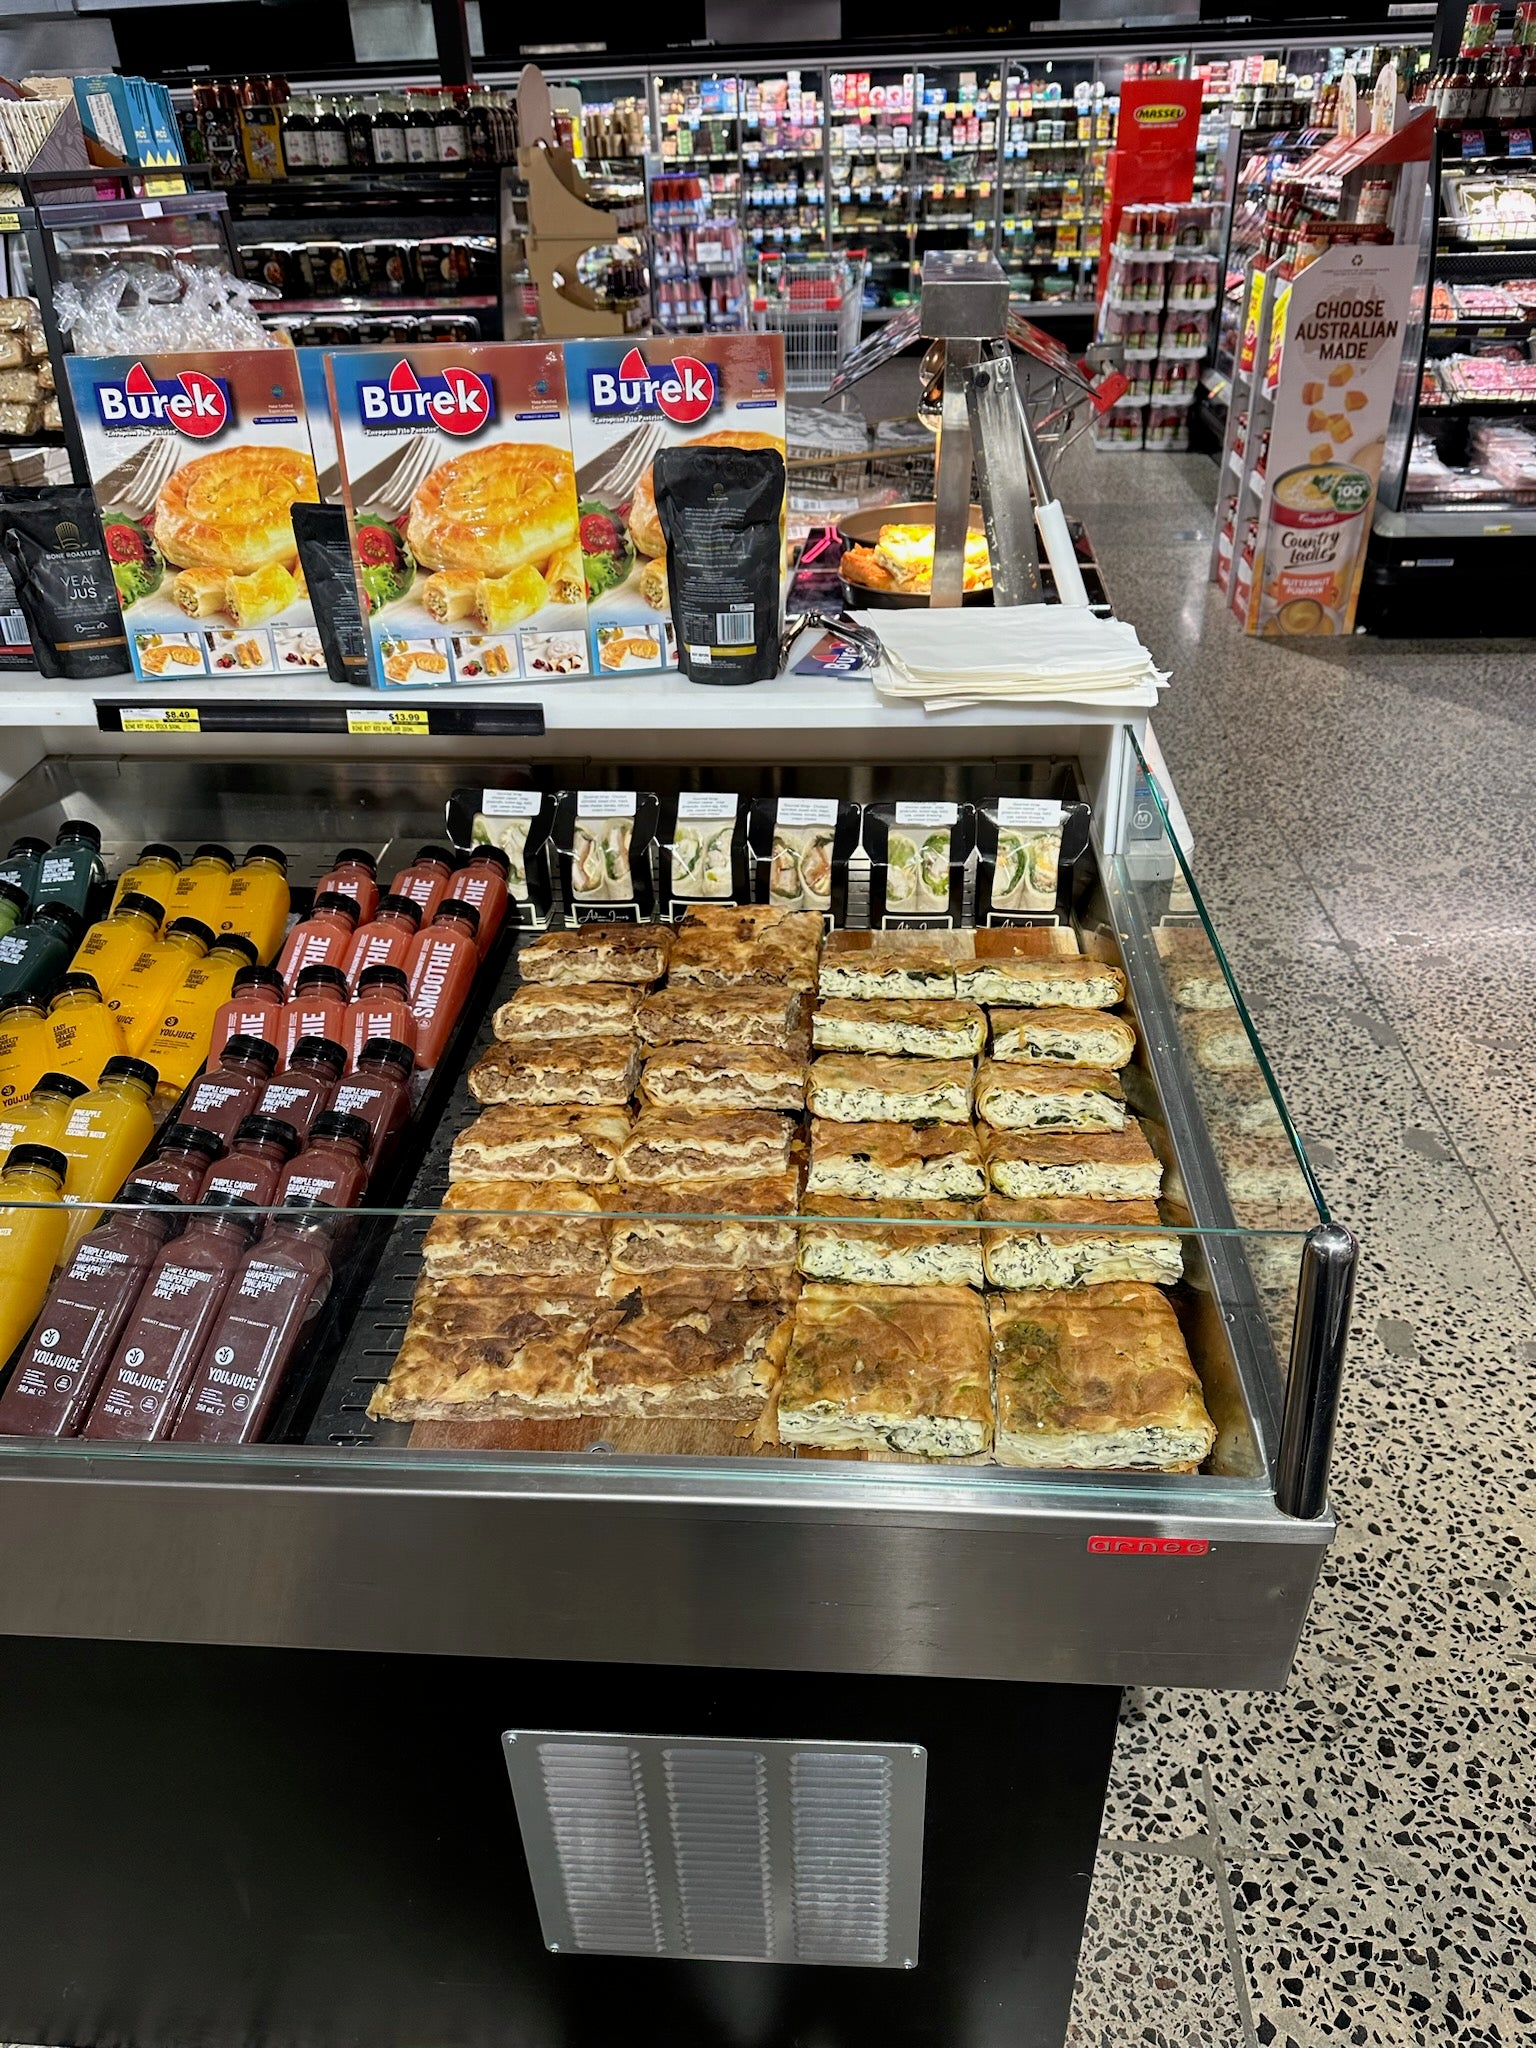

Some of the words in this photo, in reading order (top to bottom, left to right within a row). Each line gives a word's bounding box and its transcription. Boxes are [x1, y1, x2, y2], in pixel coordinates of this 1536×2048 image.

[1138, 109, 1183, 118] MASSEL
[1316, 300, 1385, 319] CHOOSE
[1295, 321, 1398, 340] AUSTRALIAN
[1319, 342, 1368, 360] MADE
[592, 368, 708, 406] Burek
[99, 383, 221, 420] Burek
[362, 379, 484, 418] Burek
[1281, 530, 1340, 549] Country
[66, 549, 101, 558] ROASTERS
[60, 575, 99, 587] VEAL
[1282, 577, 1331, 586] BUTTERNUT
[70, 587, 97, 600] JUS
[1287, 586, 1325, 595] PUMPKIN
[165, 711, 190, 719] $8.49
[388, 713, 420, 721] $13.99
[412, 941, 456, 1018] SMOOTHIE
[160, 1028, 197, 1040] YOUJUICE
[196, 1090, 229, 1101] GRAPEFRUIT
[199, 1084, 220, 1093] PURPLE
[219, 1086, 241, 1097] CARROT
[265, 1092, 297, 1102] GRAPEFRUIT
[268, 1084, 288, 1094] PURPLE
[287, 1087, 310, 1098] CARROT
[339, 1085, 361, 1094] PURPLE
[360, 1088, 382, 1098] CARROT
[193, 1098, 223, 1108] PINEAPPLE
[263, 1098, 291, 1108] PINEAPPLE
[335, 1099, 364, 1109] PINEAPPLE
[337, 1093, 370, 1103] GRAPEFRUIT
[73, 1109, 102, 1118] PINEAPPLE
[190, 1104, 209, 1113] APPLE
[260, 1104, 279, 1114] APPLE
[333, 1106, 351, 1114] APPLE
[156, 1181, 180, 1193] CARROT
[211, 1177, 235, 1188] PURPLE
[234, 1180, 258, 1191] CARROT
[288, 1175, 312, 1186] PURPLE
[311, 1178, 336, 1189] CARROT
[286, 1185, 323, 1196] GRAPEFRUIT
[80, 1244, 104, 1257] PURPLE
[103, 1249, 129, 1263] CARROT
[76, 1253, 114, 1268] GRAPEFRUIT
[68, 1270, 90, 1281] APPLE
[72, 1262, 106, 1276] PINEAPPLE
[163, 1263, 188, 1277] PURPLE
[187, 1269, 213, 1282] CARROT
[248, 1260, 274, 1273] PURPLE
[273, 1266, 298, 1279] CARROT
[160, 1271, 198, 1288] GRAPEFRUIT
[245, 1269, 285, 1285] GRAPEFRUIT
[156, 1279, 191, 1295] PINEAPPLE
[242, 1277, 277, 1292] PINEAPPLE
[152, 1288, 174, 1300] APPLE
[239, 1286, 260, 1298] APPLE
[32, 1349, 82, 1373] YOUJUICE
[118, 1368, 167, 1393] YOUJUICE
[208, 1367, 258, 1391] YOUJUICE
